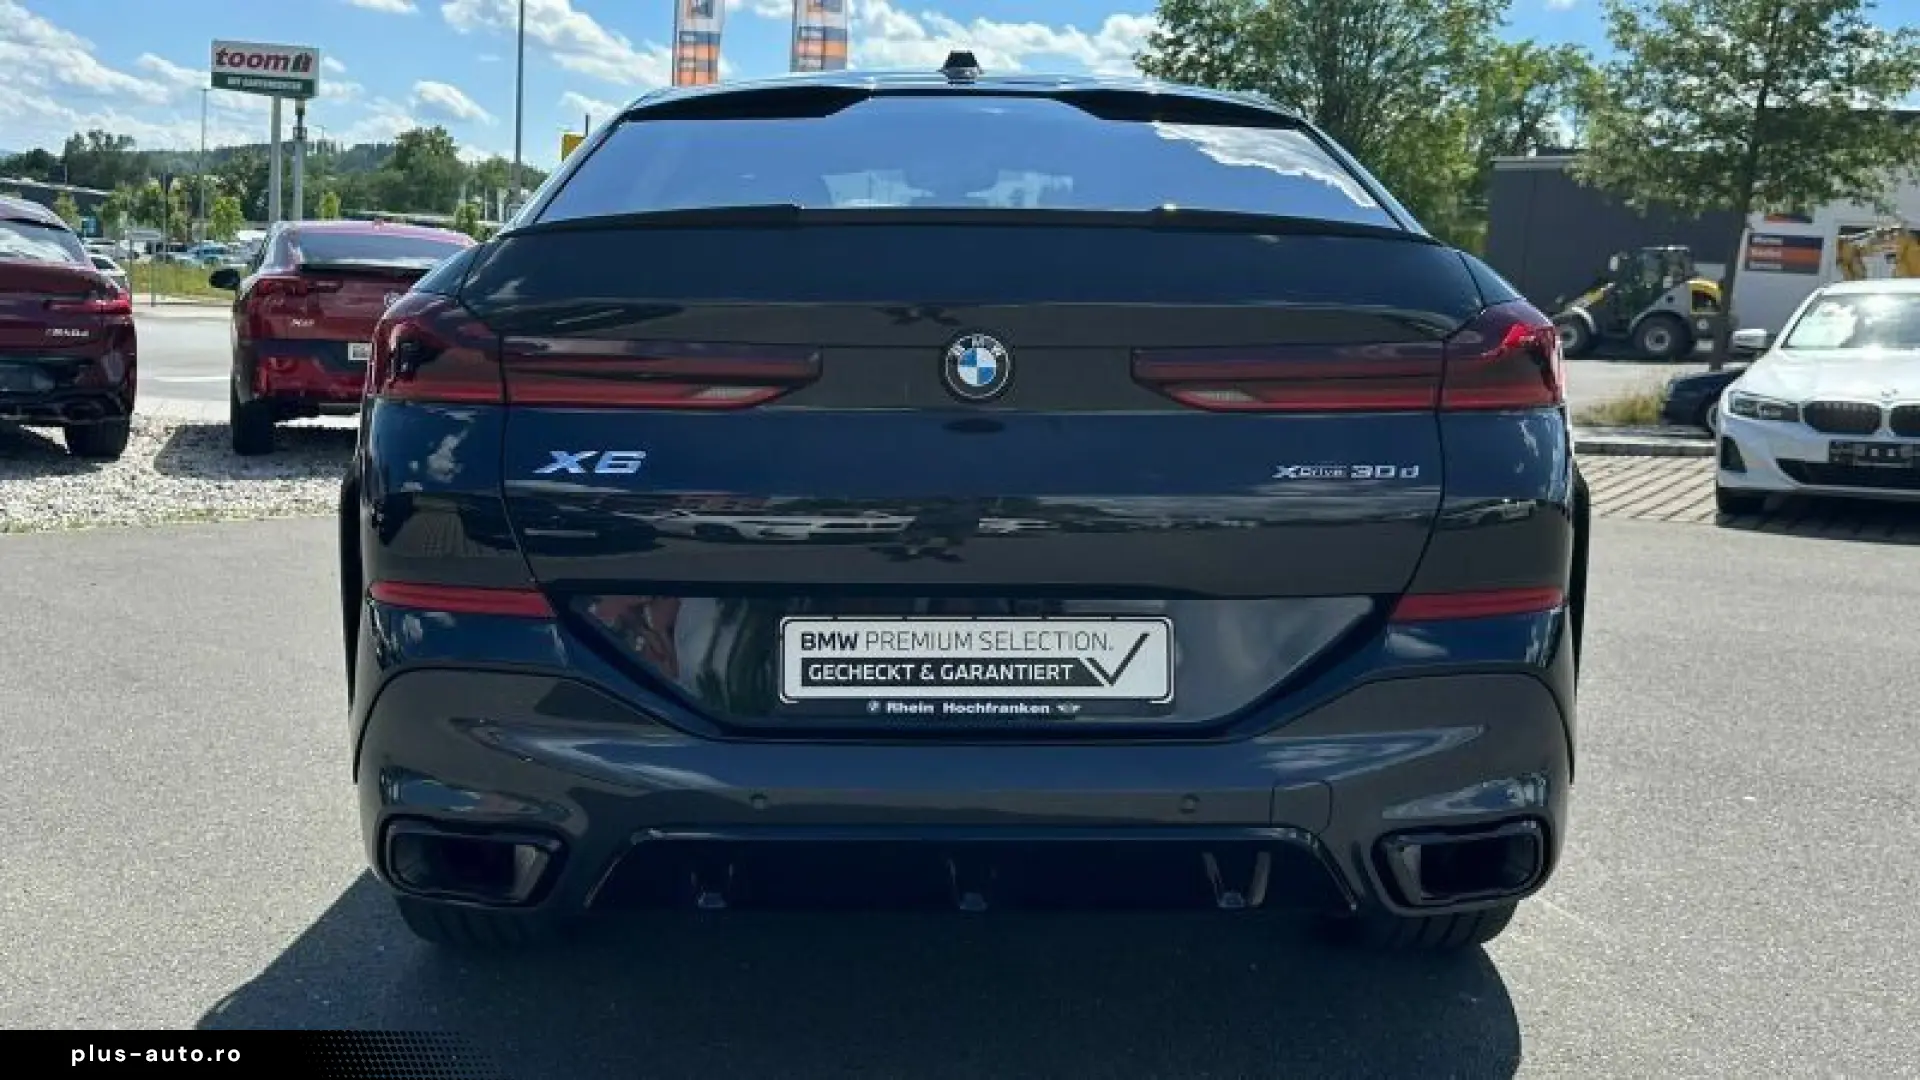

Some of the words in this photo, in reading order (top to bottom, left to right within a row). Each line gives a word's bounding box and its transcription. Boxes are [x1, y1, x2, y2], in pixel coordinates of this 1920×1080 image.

[215, 47, 289, 71] toom
[532, 450, 647, 474] X6
[801, 631, 858, 651] BMW
[865, 631, 973, 651] PREMIUM
[978, 630, 1114, 651] SELECTION.
[808, 664, 915, 680] GECHECKT
[921, 664, 935, 680] &
[940, 664, 1074, 680] GARANTIERT
[886, 701, 935, 714] Rhein
[942, 701, 1050, 714] Hochfranken
